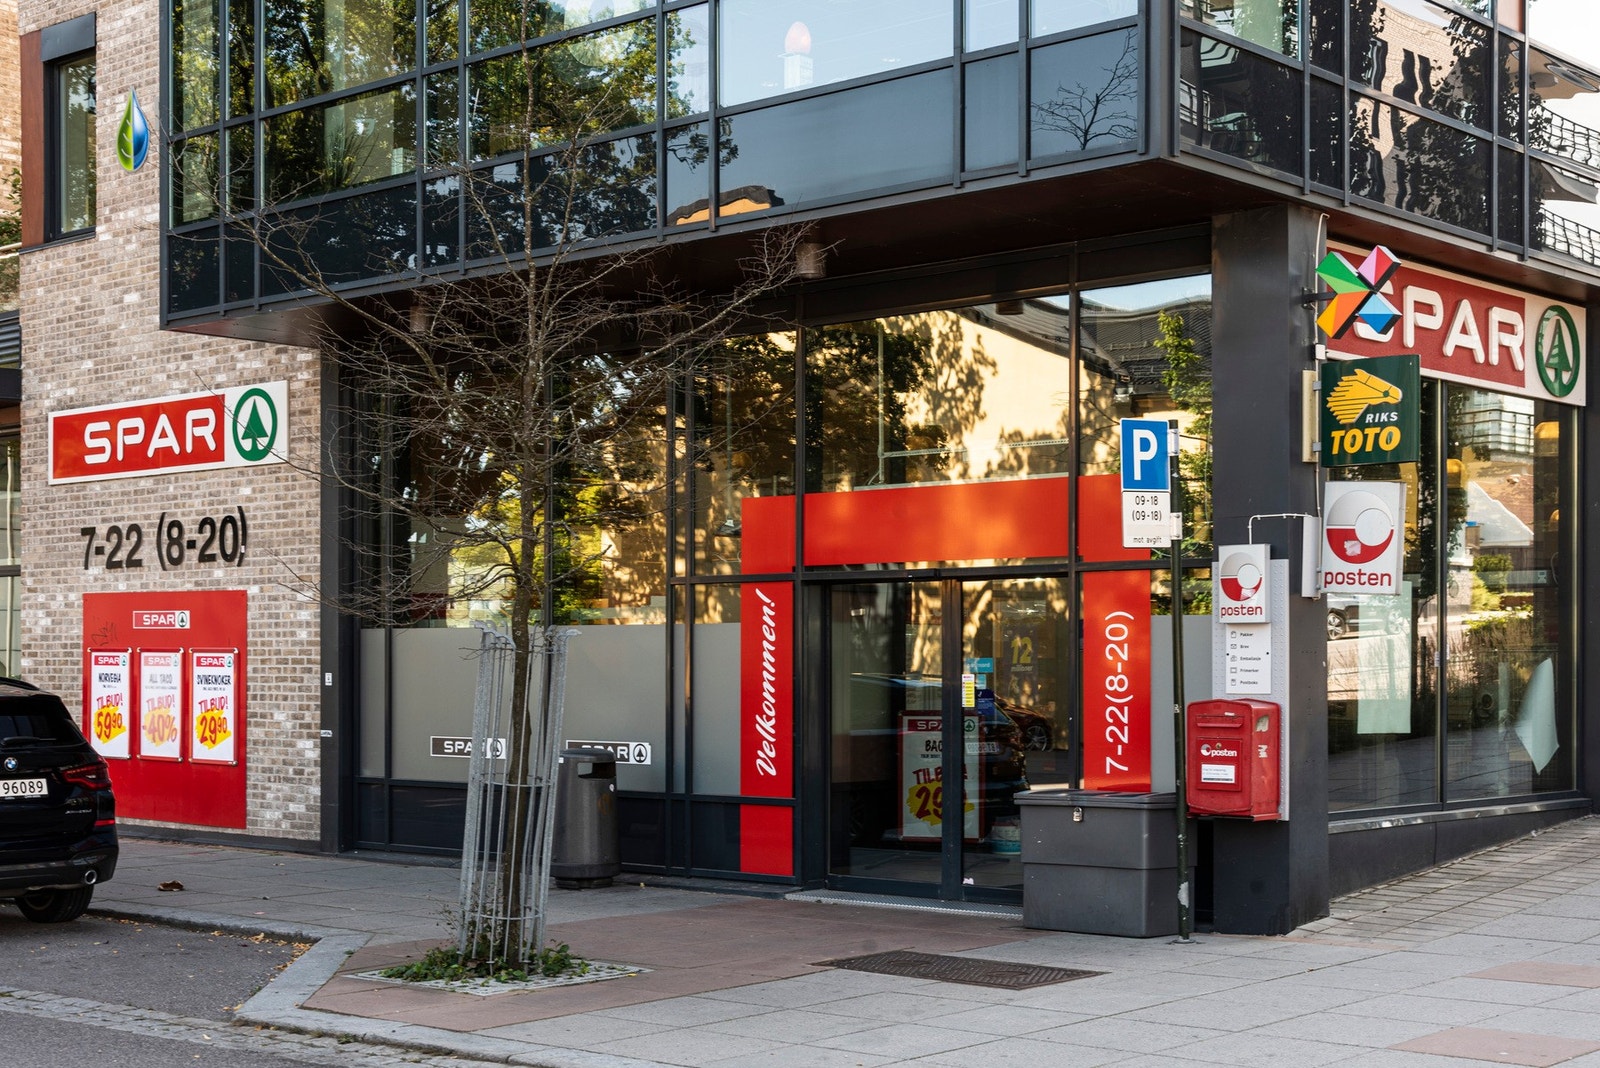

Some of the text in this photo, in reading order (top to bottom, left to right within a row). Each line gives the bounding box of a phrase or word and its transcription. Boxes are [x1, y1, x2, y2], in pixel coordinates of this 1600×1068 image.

[1365, 412, 1398, 423] RIKS
[84, 407, 217, 464] SPAR
[1330, 425, 1401, 455] TOTO
[1133, 429, 1158, 481] P
[1135, 495, 1159, 505] 09-18
[1132, 510, 1162, 521] (09-18)
[81, 505, 247, 571] 7-22 (8-20)
[1147, 536, 1162, 545] avgift
[1324, 568, 1392, 588] posten
[1221, 604, 1263, 618] posten
[142, 613, 175, 625] SPAR
[1010, 636, 1032, 664] 12
[97, 656, 120, 664] SPAR
[148, 656, 171, 665] SPAR
[200, 657, 225, 666] SPAR
[98, 673, 121, 683] NORVEGIA
[755, 588, 777, 776] Velkommen!
[1105, 611, 1134, 774] 7-22(8-20)
[96, 693, 123, 708] TILBUD!
[146, 694, 175, 712] TILBUD!
[198, 696, 229, 713] TILBUD!
[917, 721, 942, 730] SP
[443, 741, 495, 754] SPA
[1211, 748, 1237, 758] posten
[2, 780, 43, 795] 96089
